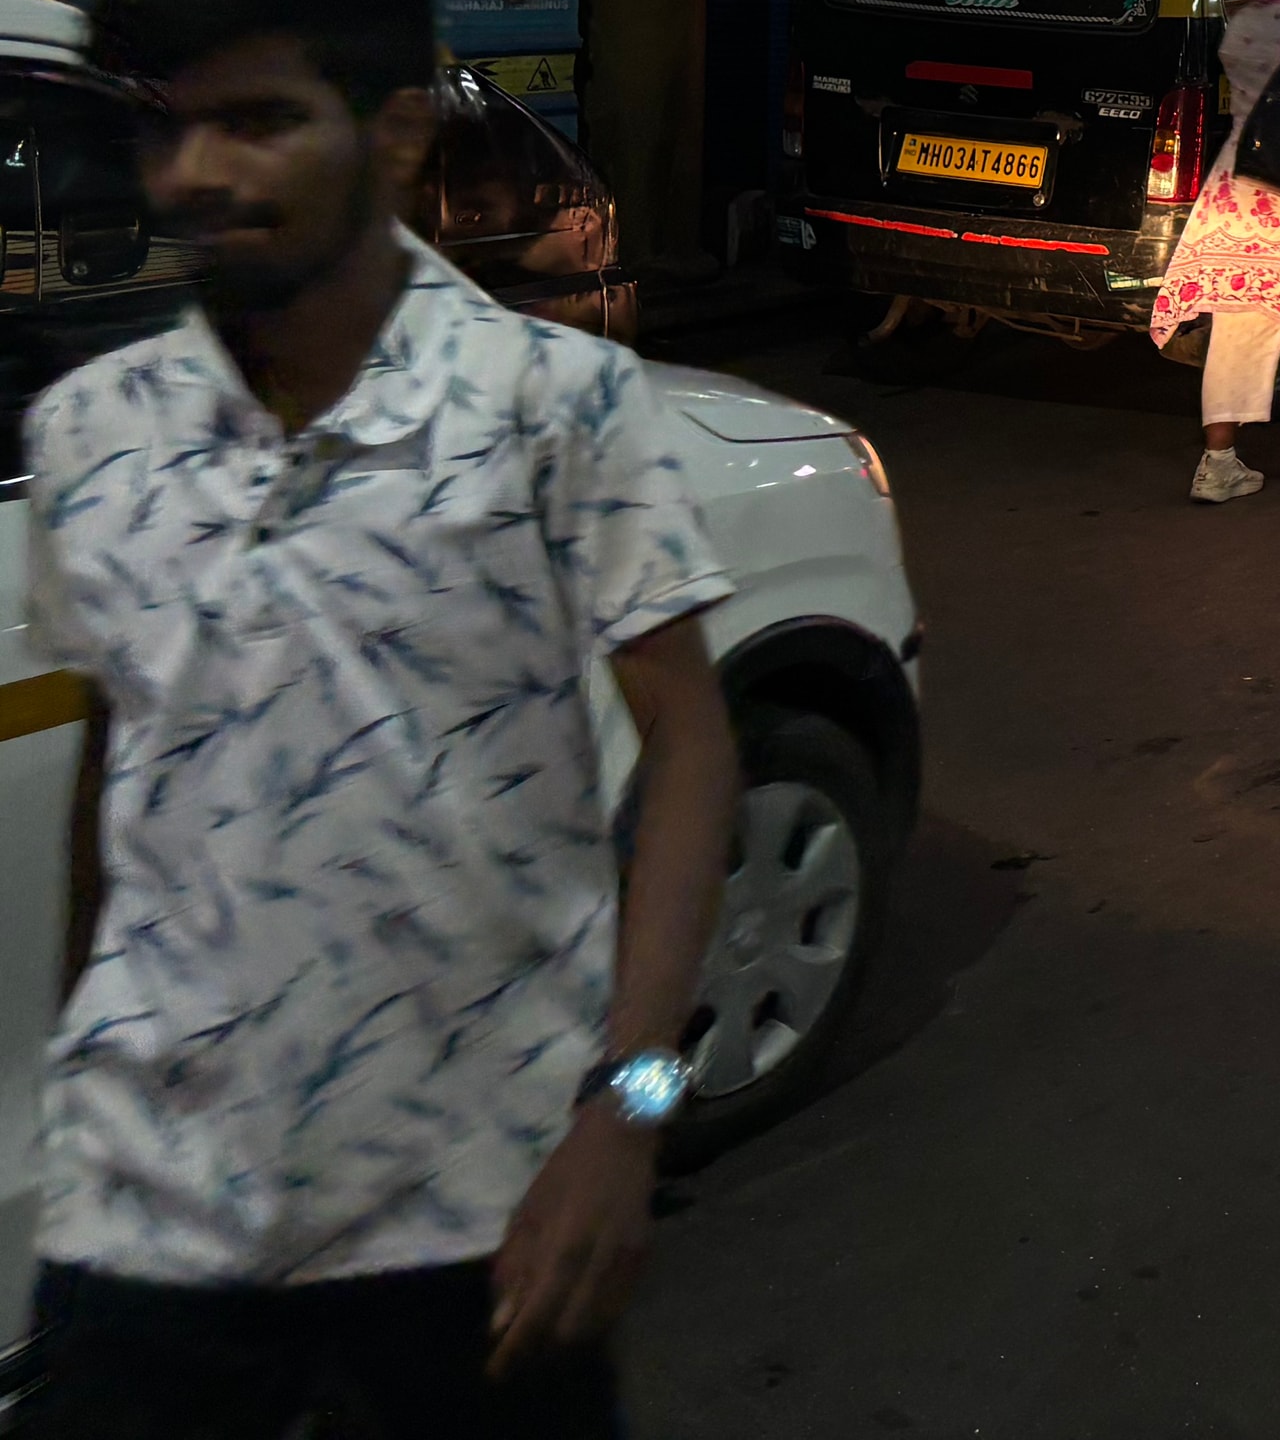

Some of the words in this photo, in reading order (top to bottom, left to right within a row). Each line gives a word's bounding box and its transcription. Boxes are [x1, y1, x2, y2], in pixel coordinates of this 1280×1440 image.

[812, 81, 851, 94] SUZUKI
[1098, 107, 1141, 120] EECO
[917, 142, 1041, 178] MH03AT4866
